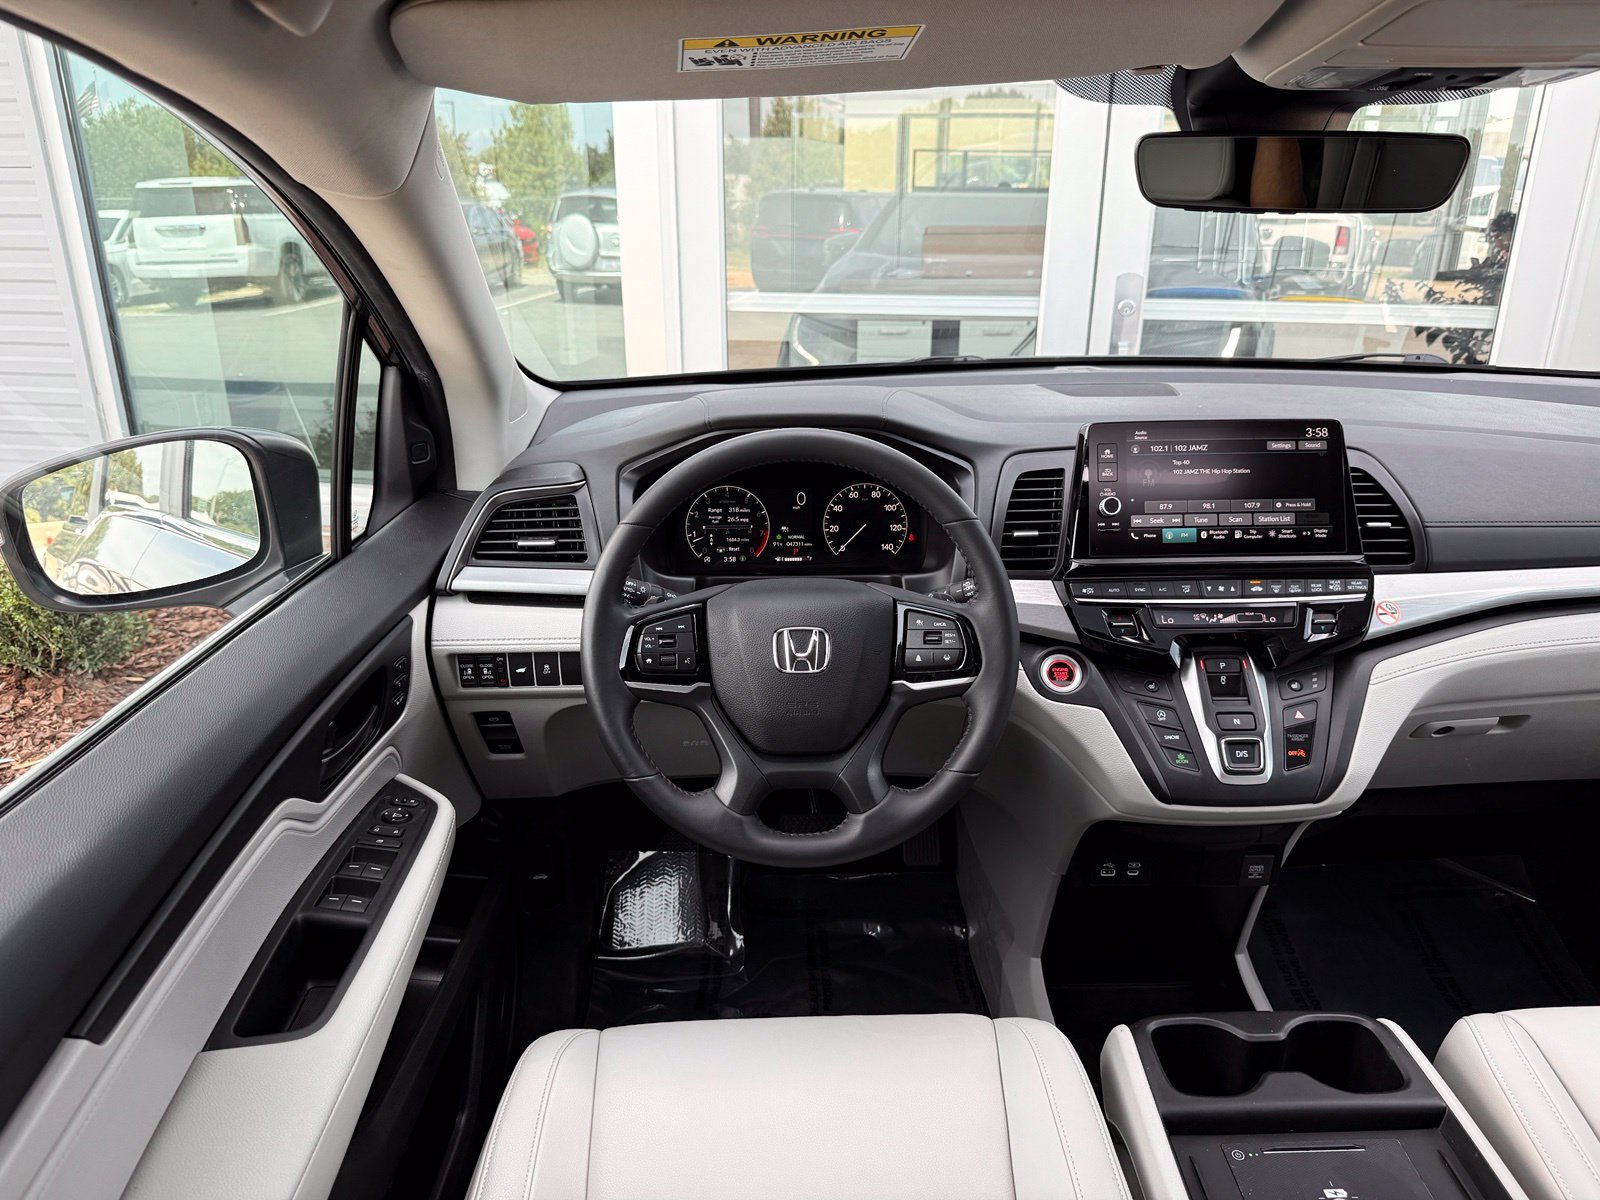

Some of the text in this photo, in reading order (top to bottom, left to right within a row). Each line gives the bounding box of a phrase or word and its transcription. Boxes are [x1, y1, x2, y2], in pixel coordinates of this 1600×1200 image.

[756, 29, 887, 46] WARNING
[770, 42, 838, 50] ADVANCED
[1306, 428, 1328, 437] 3:58
[796, 492, 806, 505] 0
[881, 543, 894, 551] 140
[1161, 616, 1174, 624] Lo
